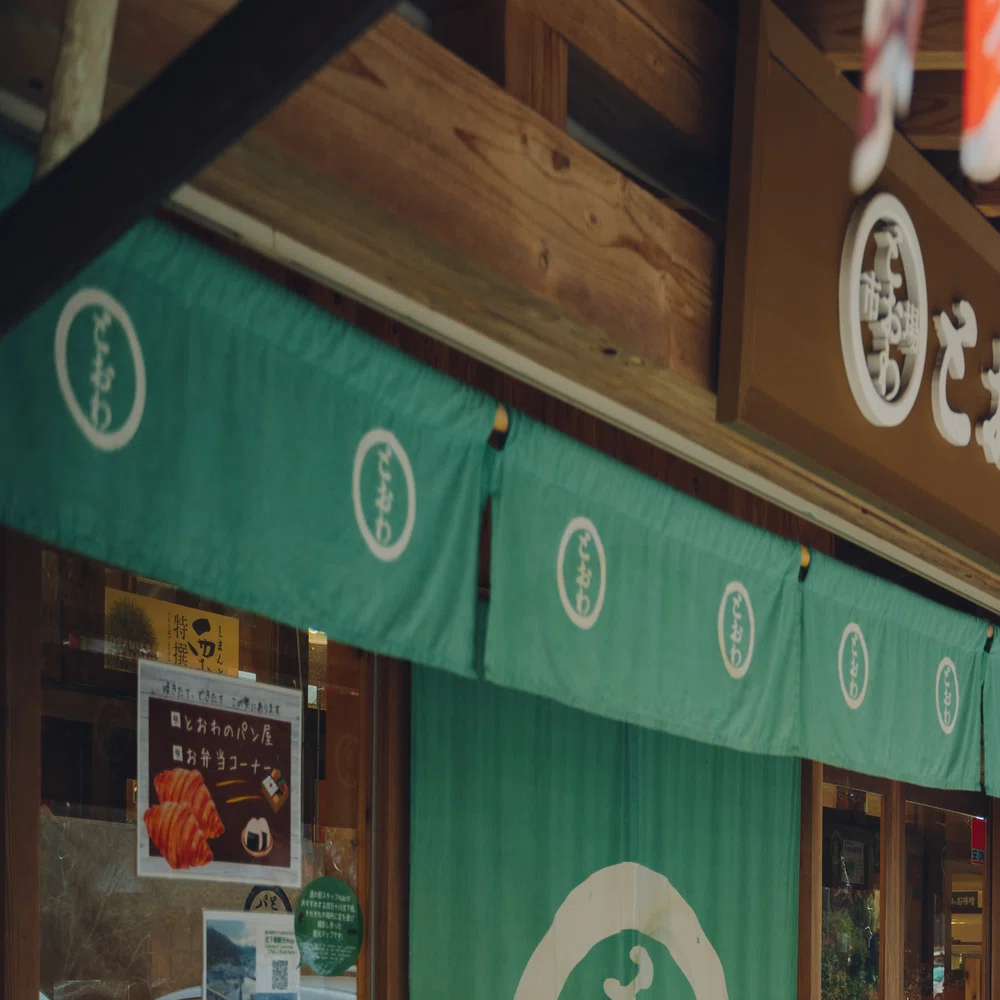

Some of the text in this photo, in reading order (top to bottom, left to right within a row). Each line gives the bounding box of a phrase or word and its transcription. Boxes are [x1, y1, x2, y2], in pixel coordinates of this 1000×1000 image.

[576, 531, 592, 617] とおわ
[731, 593, 743, 668] とおわ
[184, 714, 273, 746] とおわのパン屋
[186, 747, 271, 774] お弁当コーナー
